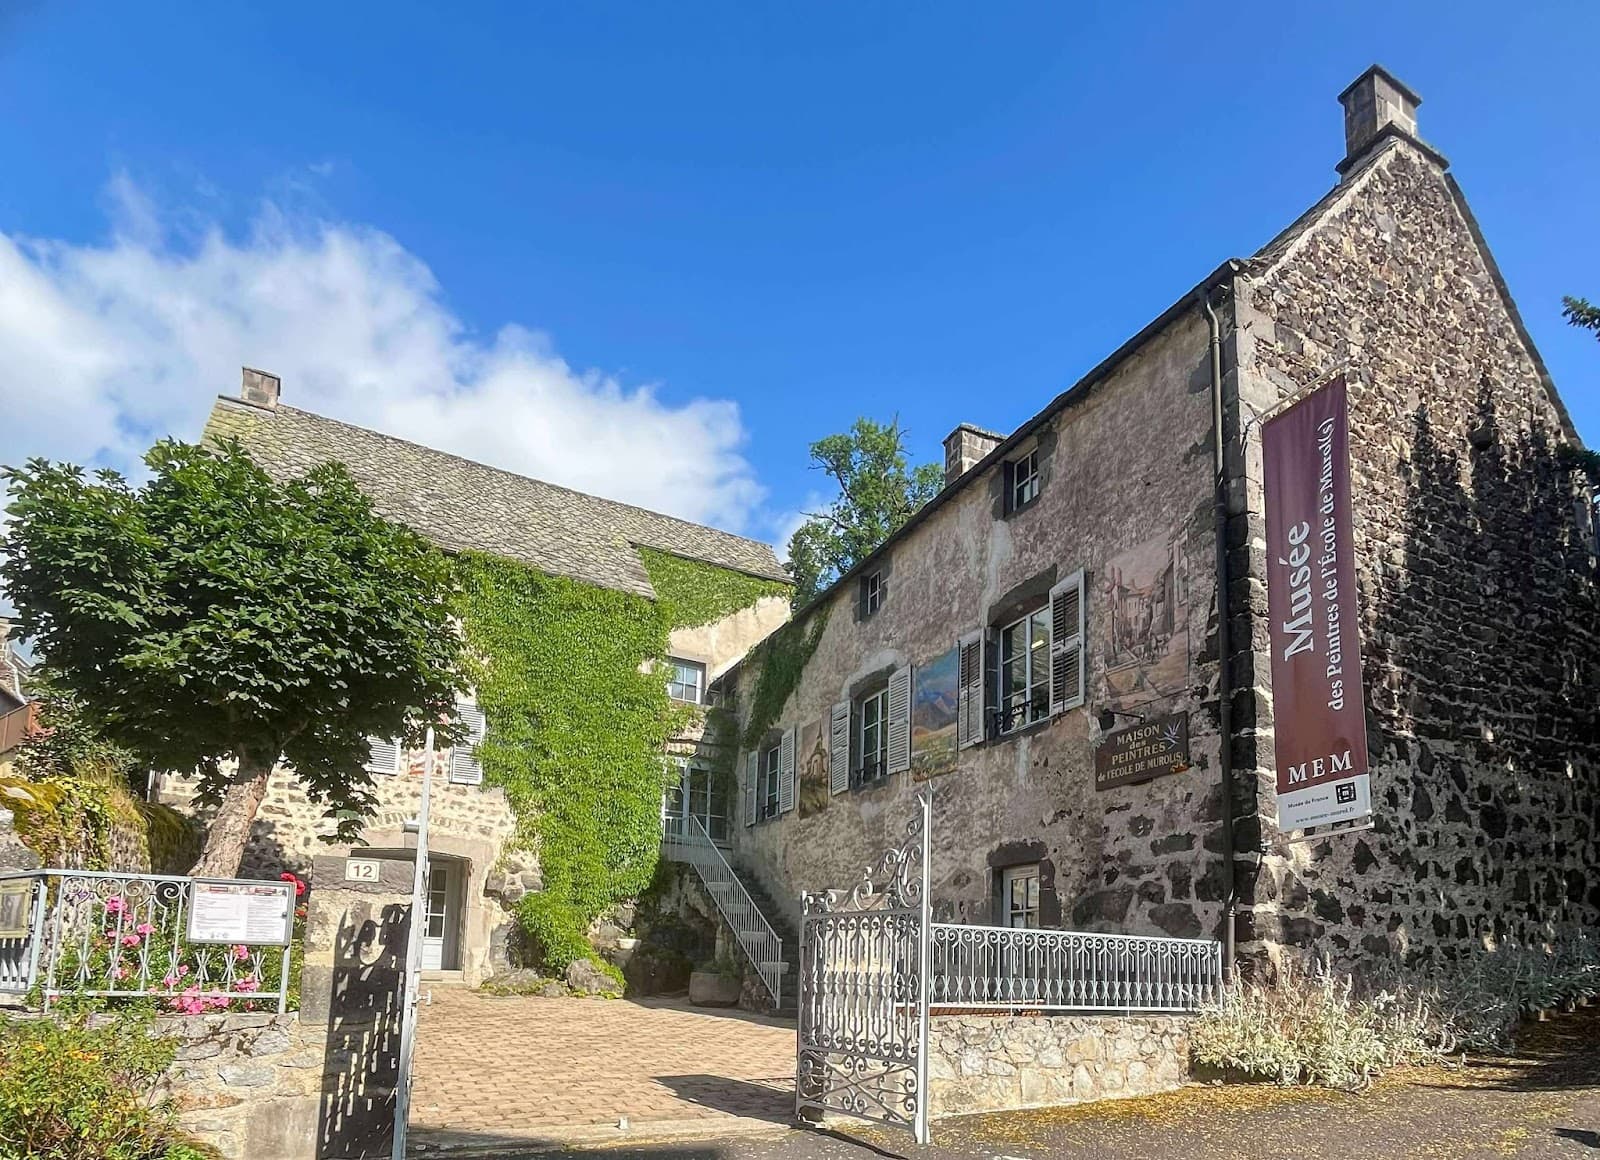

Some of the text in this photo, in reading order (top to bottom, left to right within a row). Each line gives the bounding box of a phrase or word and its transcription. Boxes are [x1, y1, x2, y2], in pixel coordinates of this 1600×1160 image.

[1317, 417, 1335, 493] Murol(s)
[1320, 492, 1334, 514] de
[1279, 521, 1315, 662] Musée
[1322, 578, 1339, 601] de
[1326, 603, 1342, 678] Peintres
[1328, 679, 1344, 710] des
[1116, 724, 1160, 746] MAISON
[1129, 740, 1146, 750] des
[1112, 742, 1166, 765] PEINTRES
[1098, 772, 1106, 782] de
[1135, 761, 1146, 772] DE
[1288, 750, 1353, 785] MEM
[353, 864, 372, 878] 12
